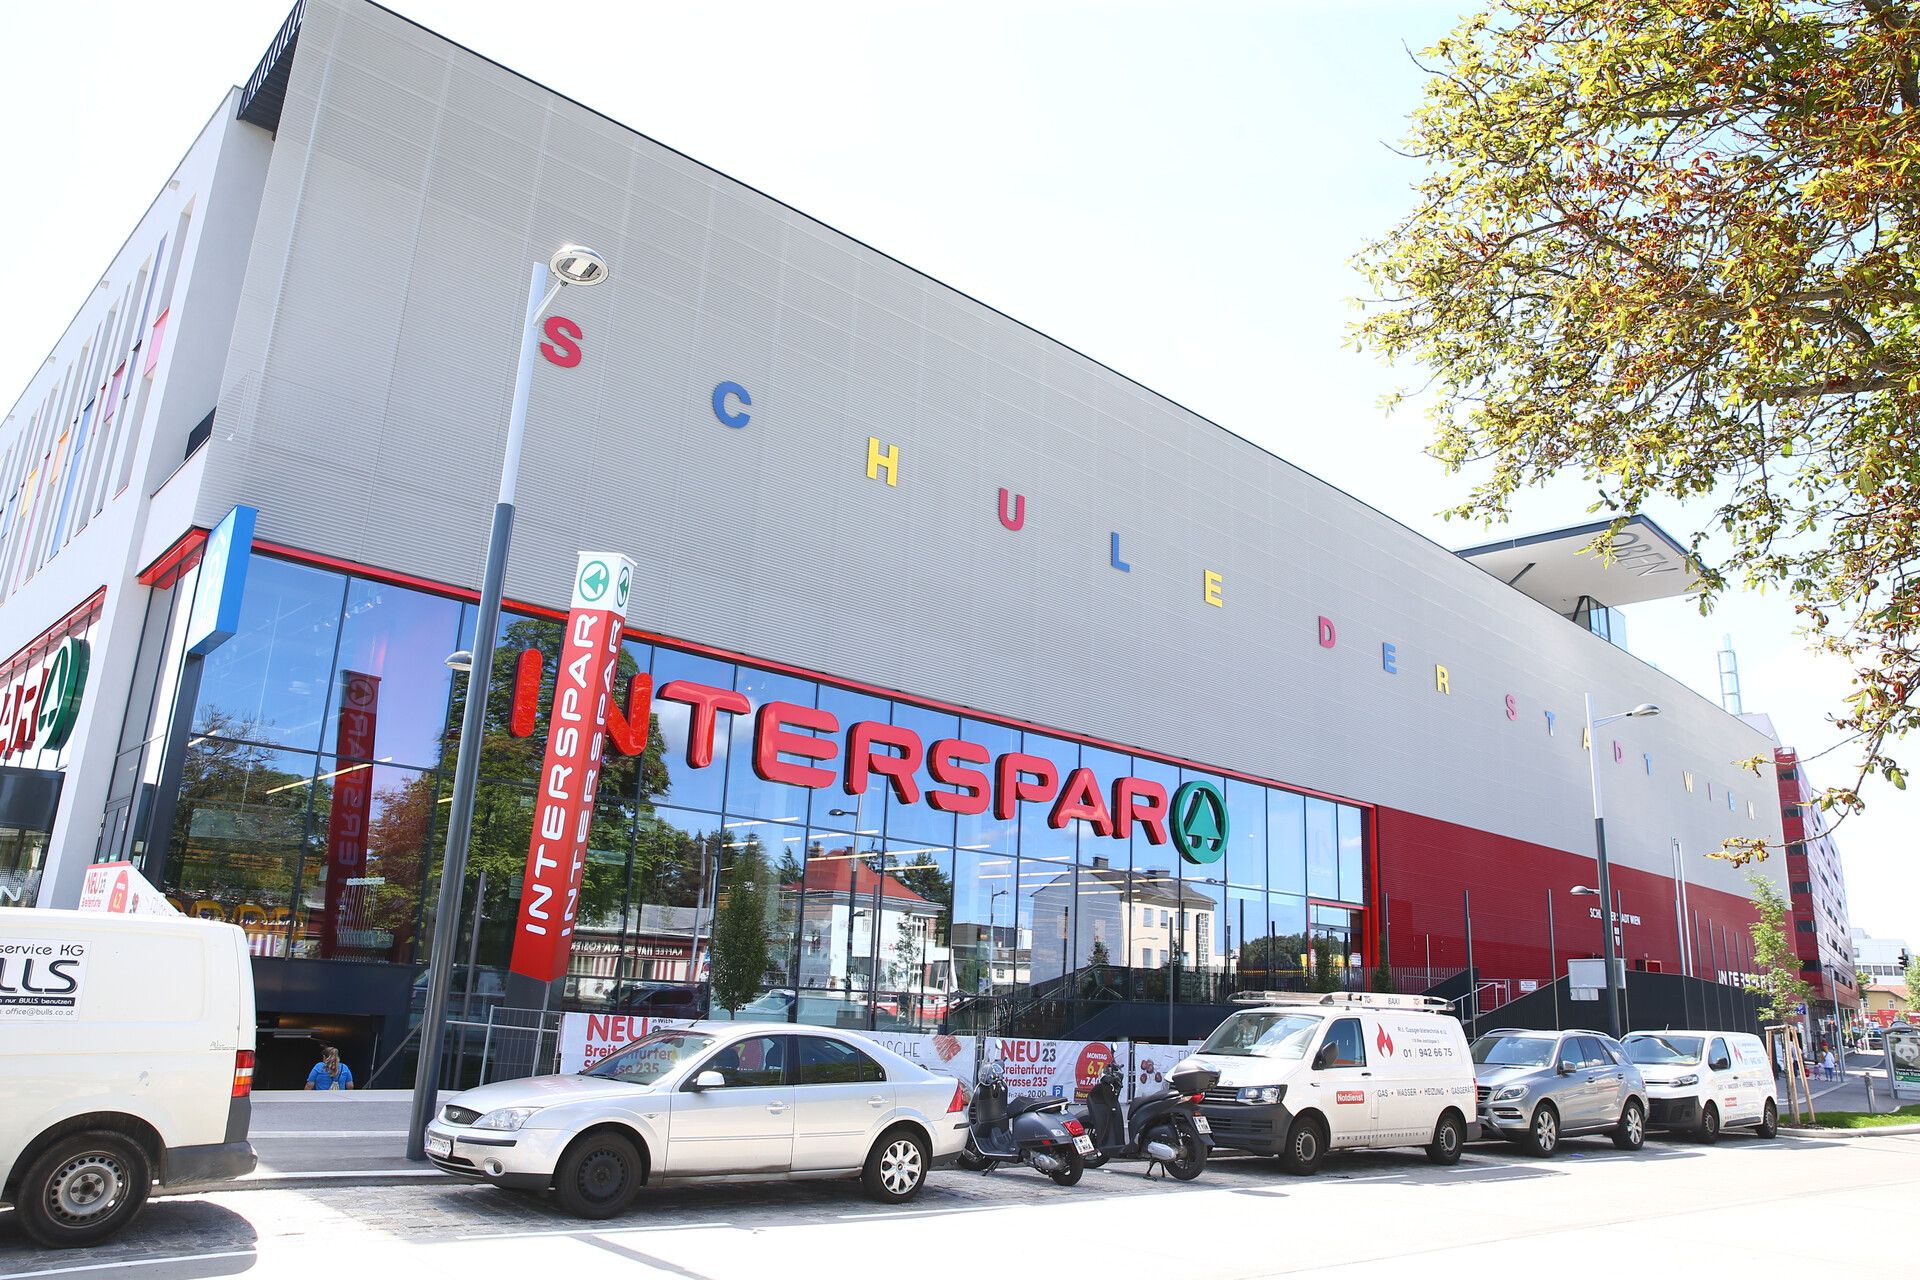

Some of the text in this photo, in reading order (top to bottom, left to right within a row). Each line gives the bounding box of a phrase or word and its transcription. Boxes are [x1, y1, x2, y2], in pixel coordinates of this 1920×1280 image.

[540, 316, 1224, 609] SCHULE
[1318, 615, 1450, 695] DER
[1683, 770, 1755, 821] WIEN
[510, 648, 1167, 846] INTERSPAR
[526, 613, 599, 935] INTERSPAR
[561, 618, 622, 937] INTERSPAR
[60, 944, 84, 957] KG
[586, 1014, 648, 1042] NEU
[1001, 1039, 1040, 1063] NEU
[1042, 1048, 1056, 1062] 23
[1087, 1052, 1108, 1060] MONTAG
[1403, 1048, 1412, 1058] 01
[1418, 1048, 1433, 1057] 942
[1443, 1047, 1453, 1057] 75
[1032, 1077, 1048, 1087] 235
[1027, 1090, 1047, 1098] 20.00
[1337, 1092, 1364, 1103] Notdienst
[1377, 1089, 1389, 1098] GAS
[1397, 1088, 1417, 1097] WASSER
